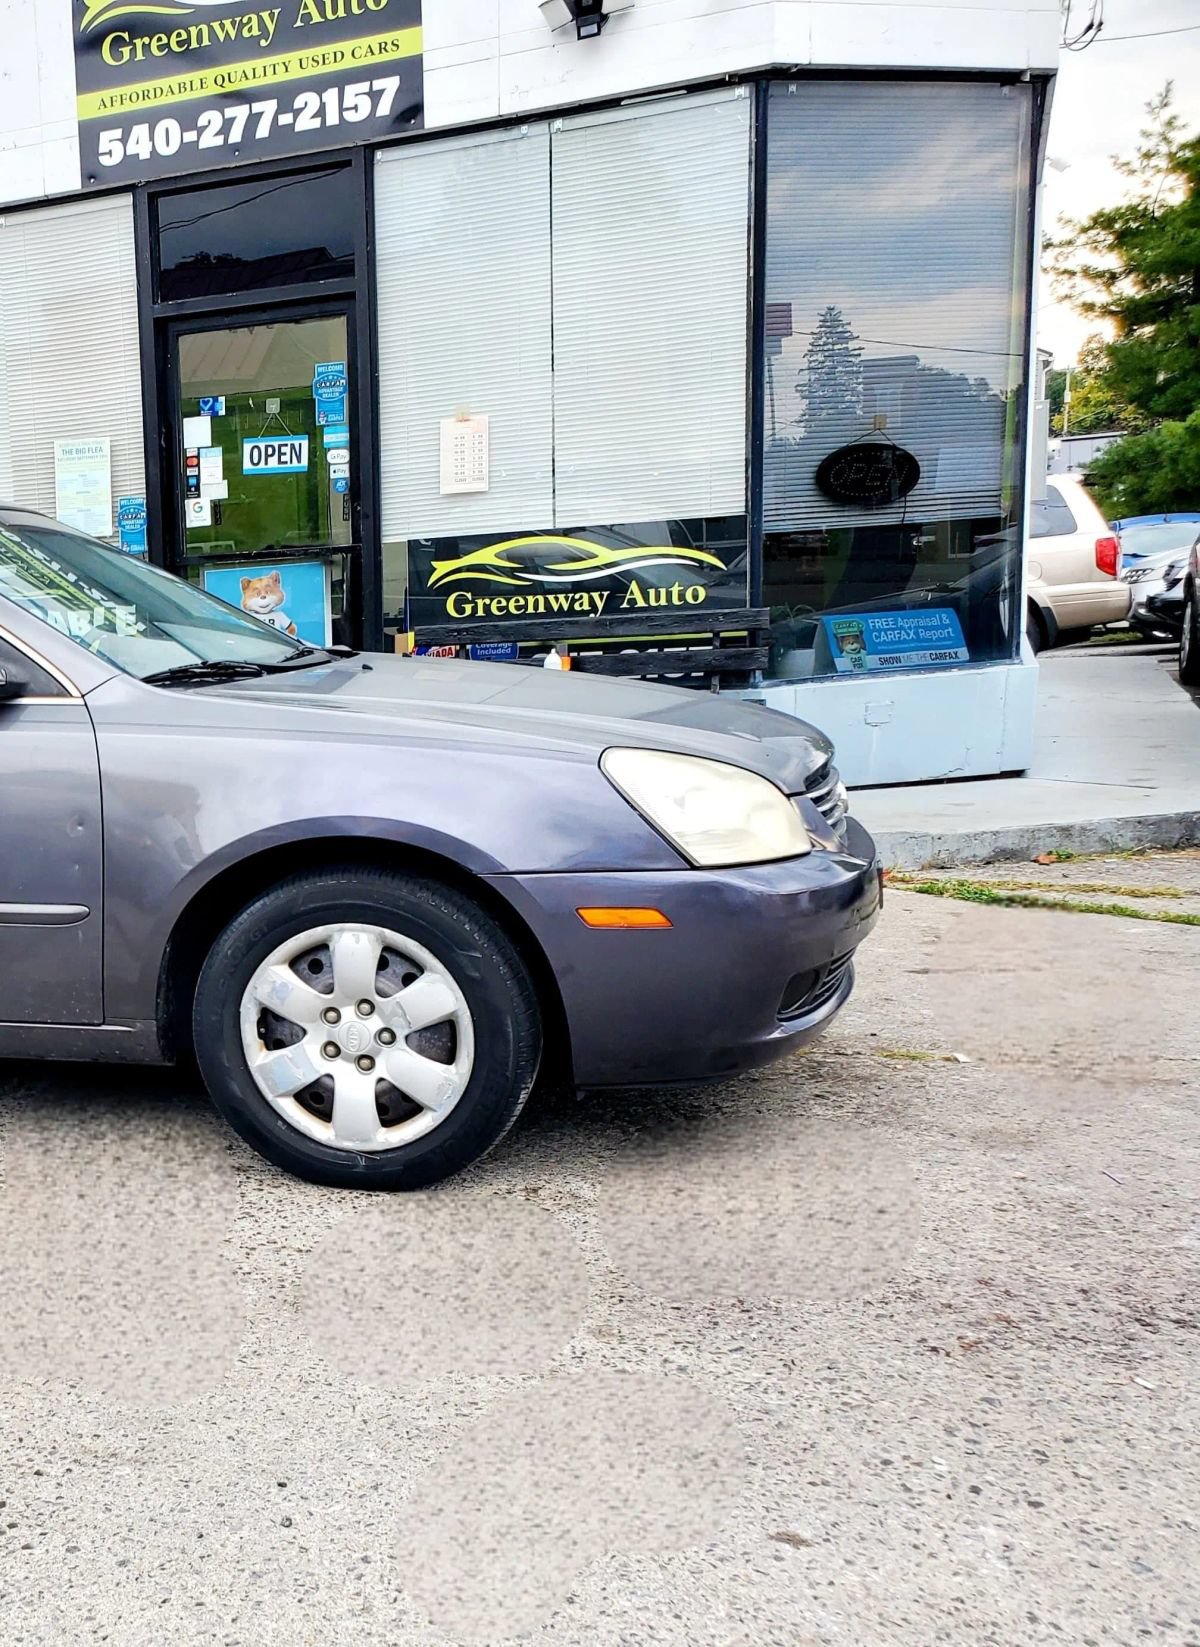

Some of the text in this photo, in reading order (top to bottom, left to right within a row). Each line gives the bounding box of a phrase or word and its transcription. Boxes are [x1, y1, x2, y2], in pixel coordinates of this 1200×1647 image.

[101, 0, 388, 66] Greenway Auto
[97, 38, 400, 110] AFFORDABLE QUALITY USED CARS
[98, 76, 401, 167] 540-277-2157
[61, 445, 104, 456] THE BIG FLEA
[249, 442, 303, 467] OPEN
[446, 580, 707, 618] Greenway Auto
[868, 617, 897, 630] FREE
[898, 614, 940, 628] Appraisal
[942, 613, 950, 625] &
[872, 629, 916, 642] CARFAX
[919, 627, 955, 641] Report
[477, 647, 511, 656] Included
[878, 655, 902, 666] SHOW
[929, 650, 960, 661] CARFAX
